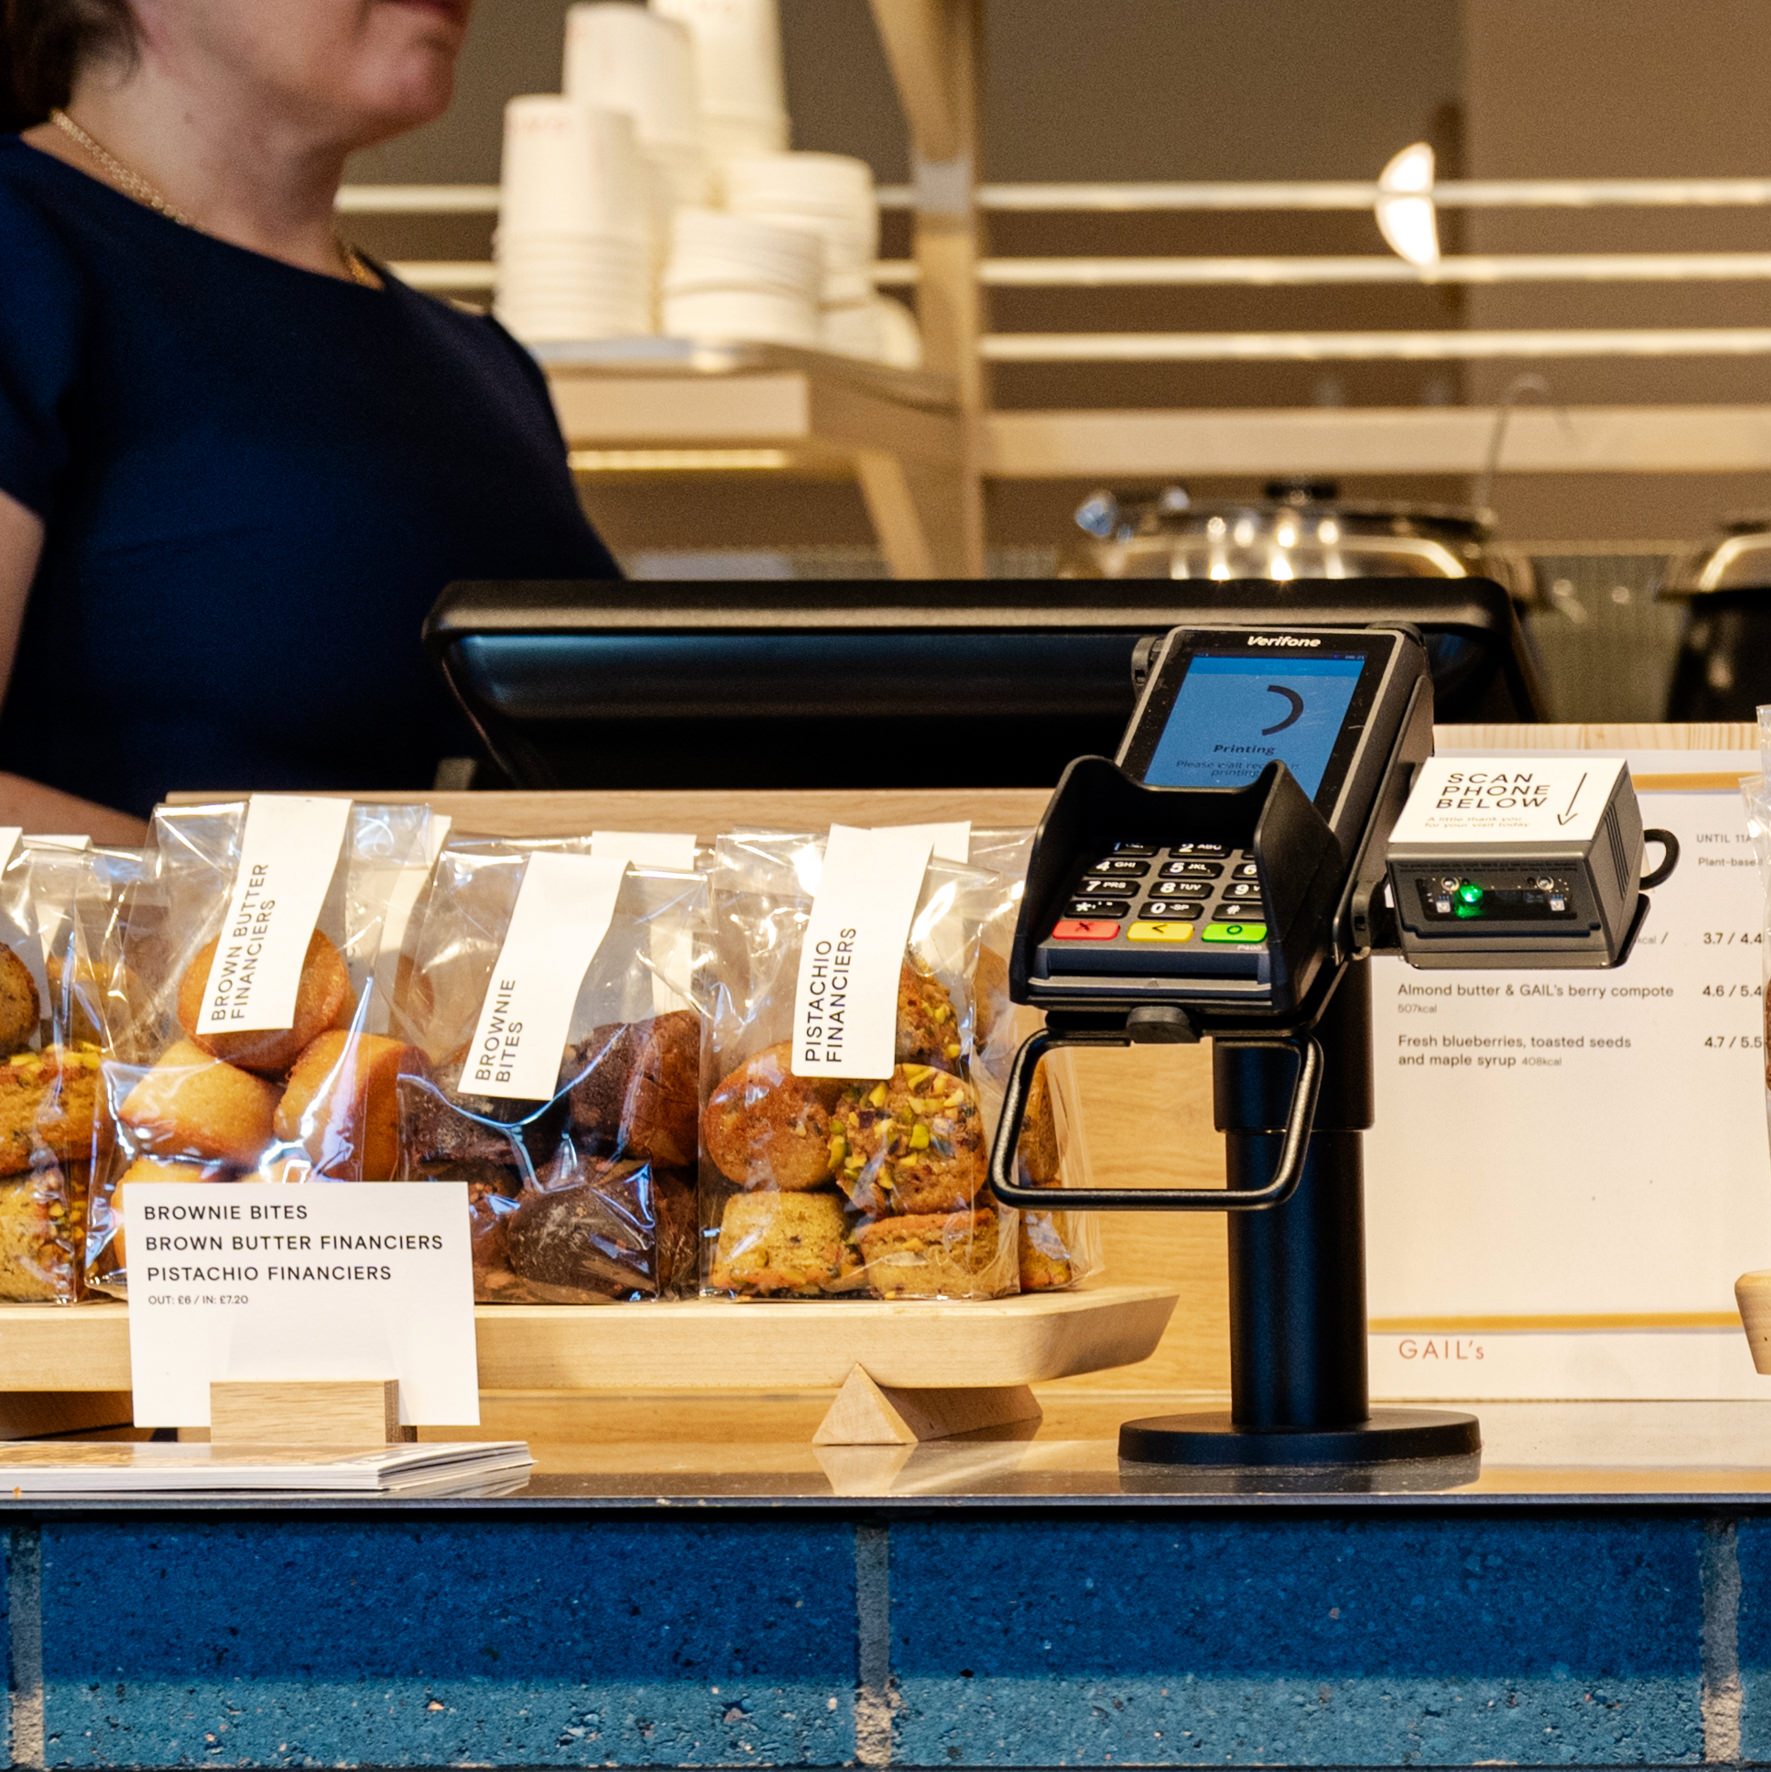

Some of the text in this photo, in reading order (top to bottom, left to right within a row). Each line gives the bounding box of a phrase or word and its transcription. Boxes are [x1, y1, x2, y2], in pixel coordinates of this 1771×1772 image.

[1247, 636, 1321, 648] Verifone
[1213, 744, 1275, 755] Printing
[1447, 773, 1533, 784] SCAN
[1441, 785, 1551, 797] PHONE
[1436, 797, 1547, 809] BELOW
[1697, 834, 1730, 843] UNTIL
[1096, 861, 1111, 871] 4
[1169, 863, 1185, 873] 5
[1086, 881, 1101, 891] 7
[1160, 883, 1176, 893] 8
[210, 863, 269, 1021] BROWN BUTTER
[1703, 932, 1762, 945] 3.7 / 4.4
[230, 899, 276, 1019] FINANCIERS
[826, 927, 857, 1063] FINANCIERS
[1398, 984, 1674, 1000] Almond butter & GAIL's berry compote
[1702, 984, 1762, 997] 4.6 / 5.4
[805, 940, 832, 1062] PISTACHIO
[1398, 1004, 1437, 1013] 507kcal
[475, 979, 516, 1081] BROWNIE
[1398, 1035, 1631, 1050] Fresh blueberries, toasted seeds
[1704, 1036, 1762, 1048] 4.7 / 5.5
[495, 1021, 524, 1083] BITES
[1398, 1054, 1562, 1069] and maple syrup 408kcal
[144, 1205, 308, 1220] BROWNIE BITES
[146, 1235, 444, 1251] BROWN BUTTER FINANCIERS
[148, 1265, 392, 1281] PISTACHIO FINANCIERS
[148, 1295, 175, 1304] OUT:
[178, 1295, 191, 1304] £6
[202, 1295, 217, 1304] IN:
[219, 1295, 249, 1304] £7.20
[1398, 1339, 1484, 1360] GAIL's
